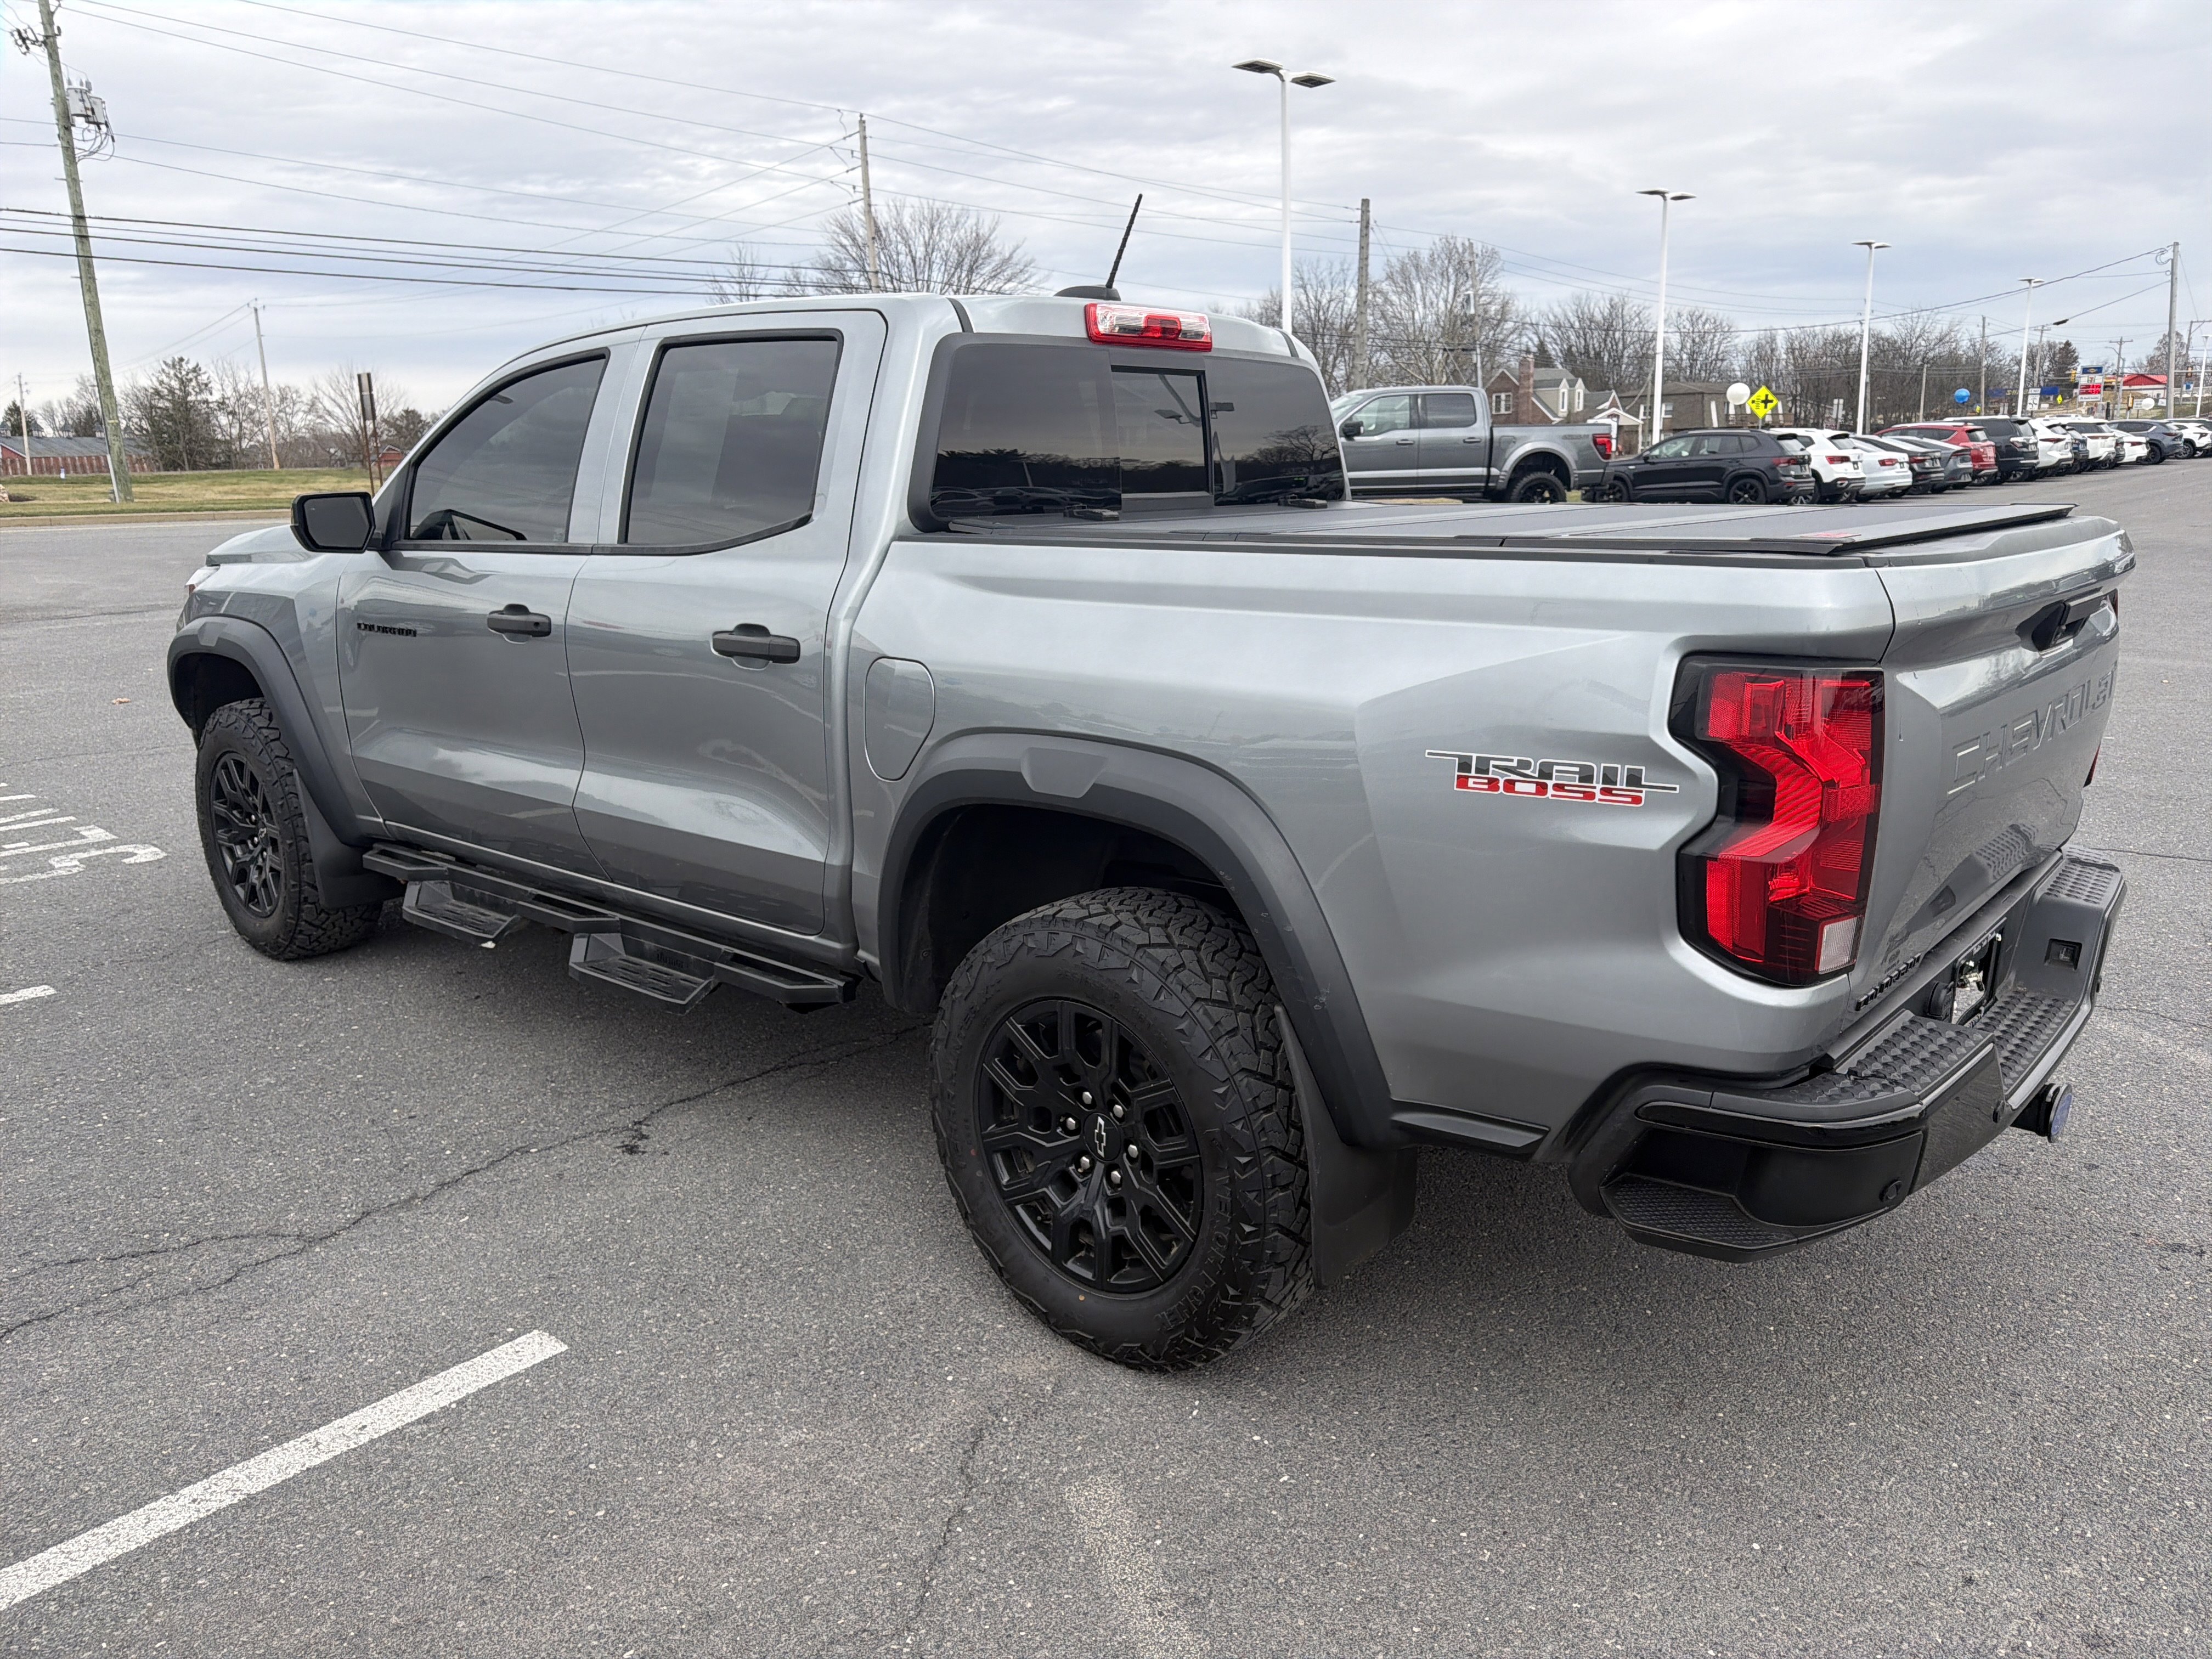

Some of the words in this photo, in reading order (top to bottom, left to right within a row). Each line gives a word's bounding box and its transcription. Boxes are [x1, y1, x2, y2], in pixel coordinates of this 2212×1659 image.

[1948, 660, 2118, 794] CHEVROLET
[1426, 749, 1679, 793] TRAIL
[1454, 774, 1645, 807] BOSS
